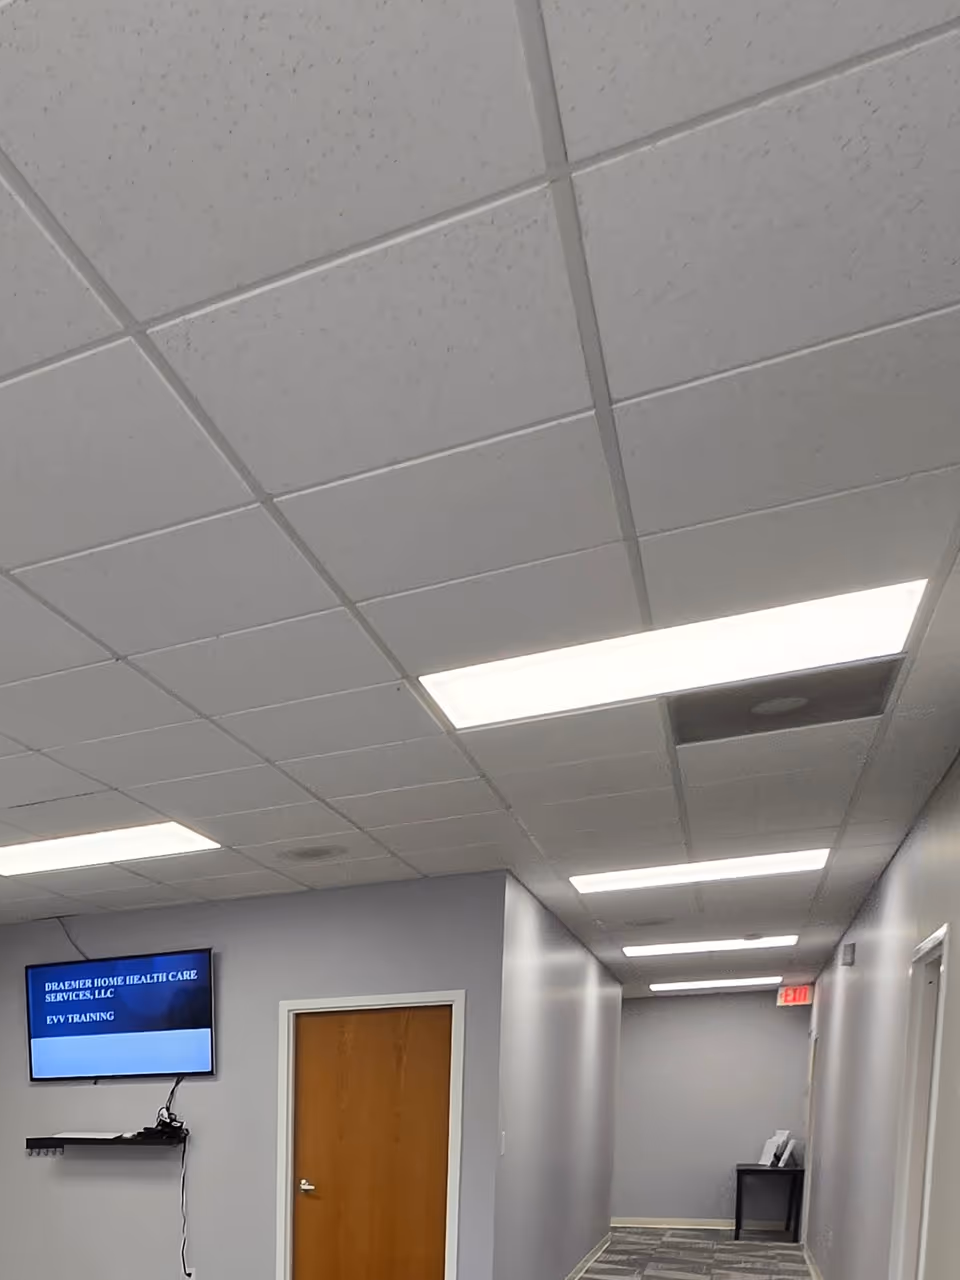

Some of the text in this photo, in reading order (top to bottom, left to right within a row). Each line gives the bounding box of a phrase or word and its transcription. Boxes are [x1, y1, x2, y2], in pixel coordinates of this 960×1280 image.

[45, 970, 198, 991] DRAEMER HOME HEALTH CARE
[45, 988, 115, 1002] SERVICES, LLC
[46, 1011, 115, 1025] EVV TRAINING
